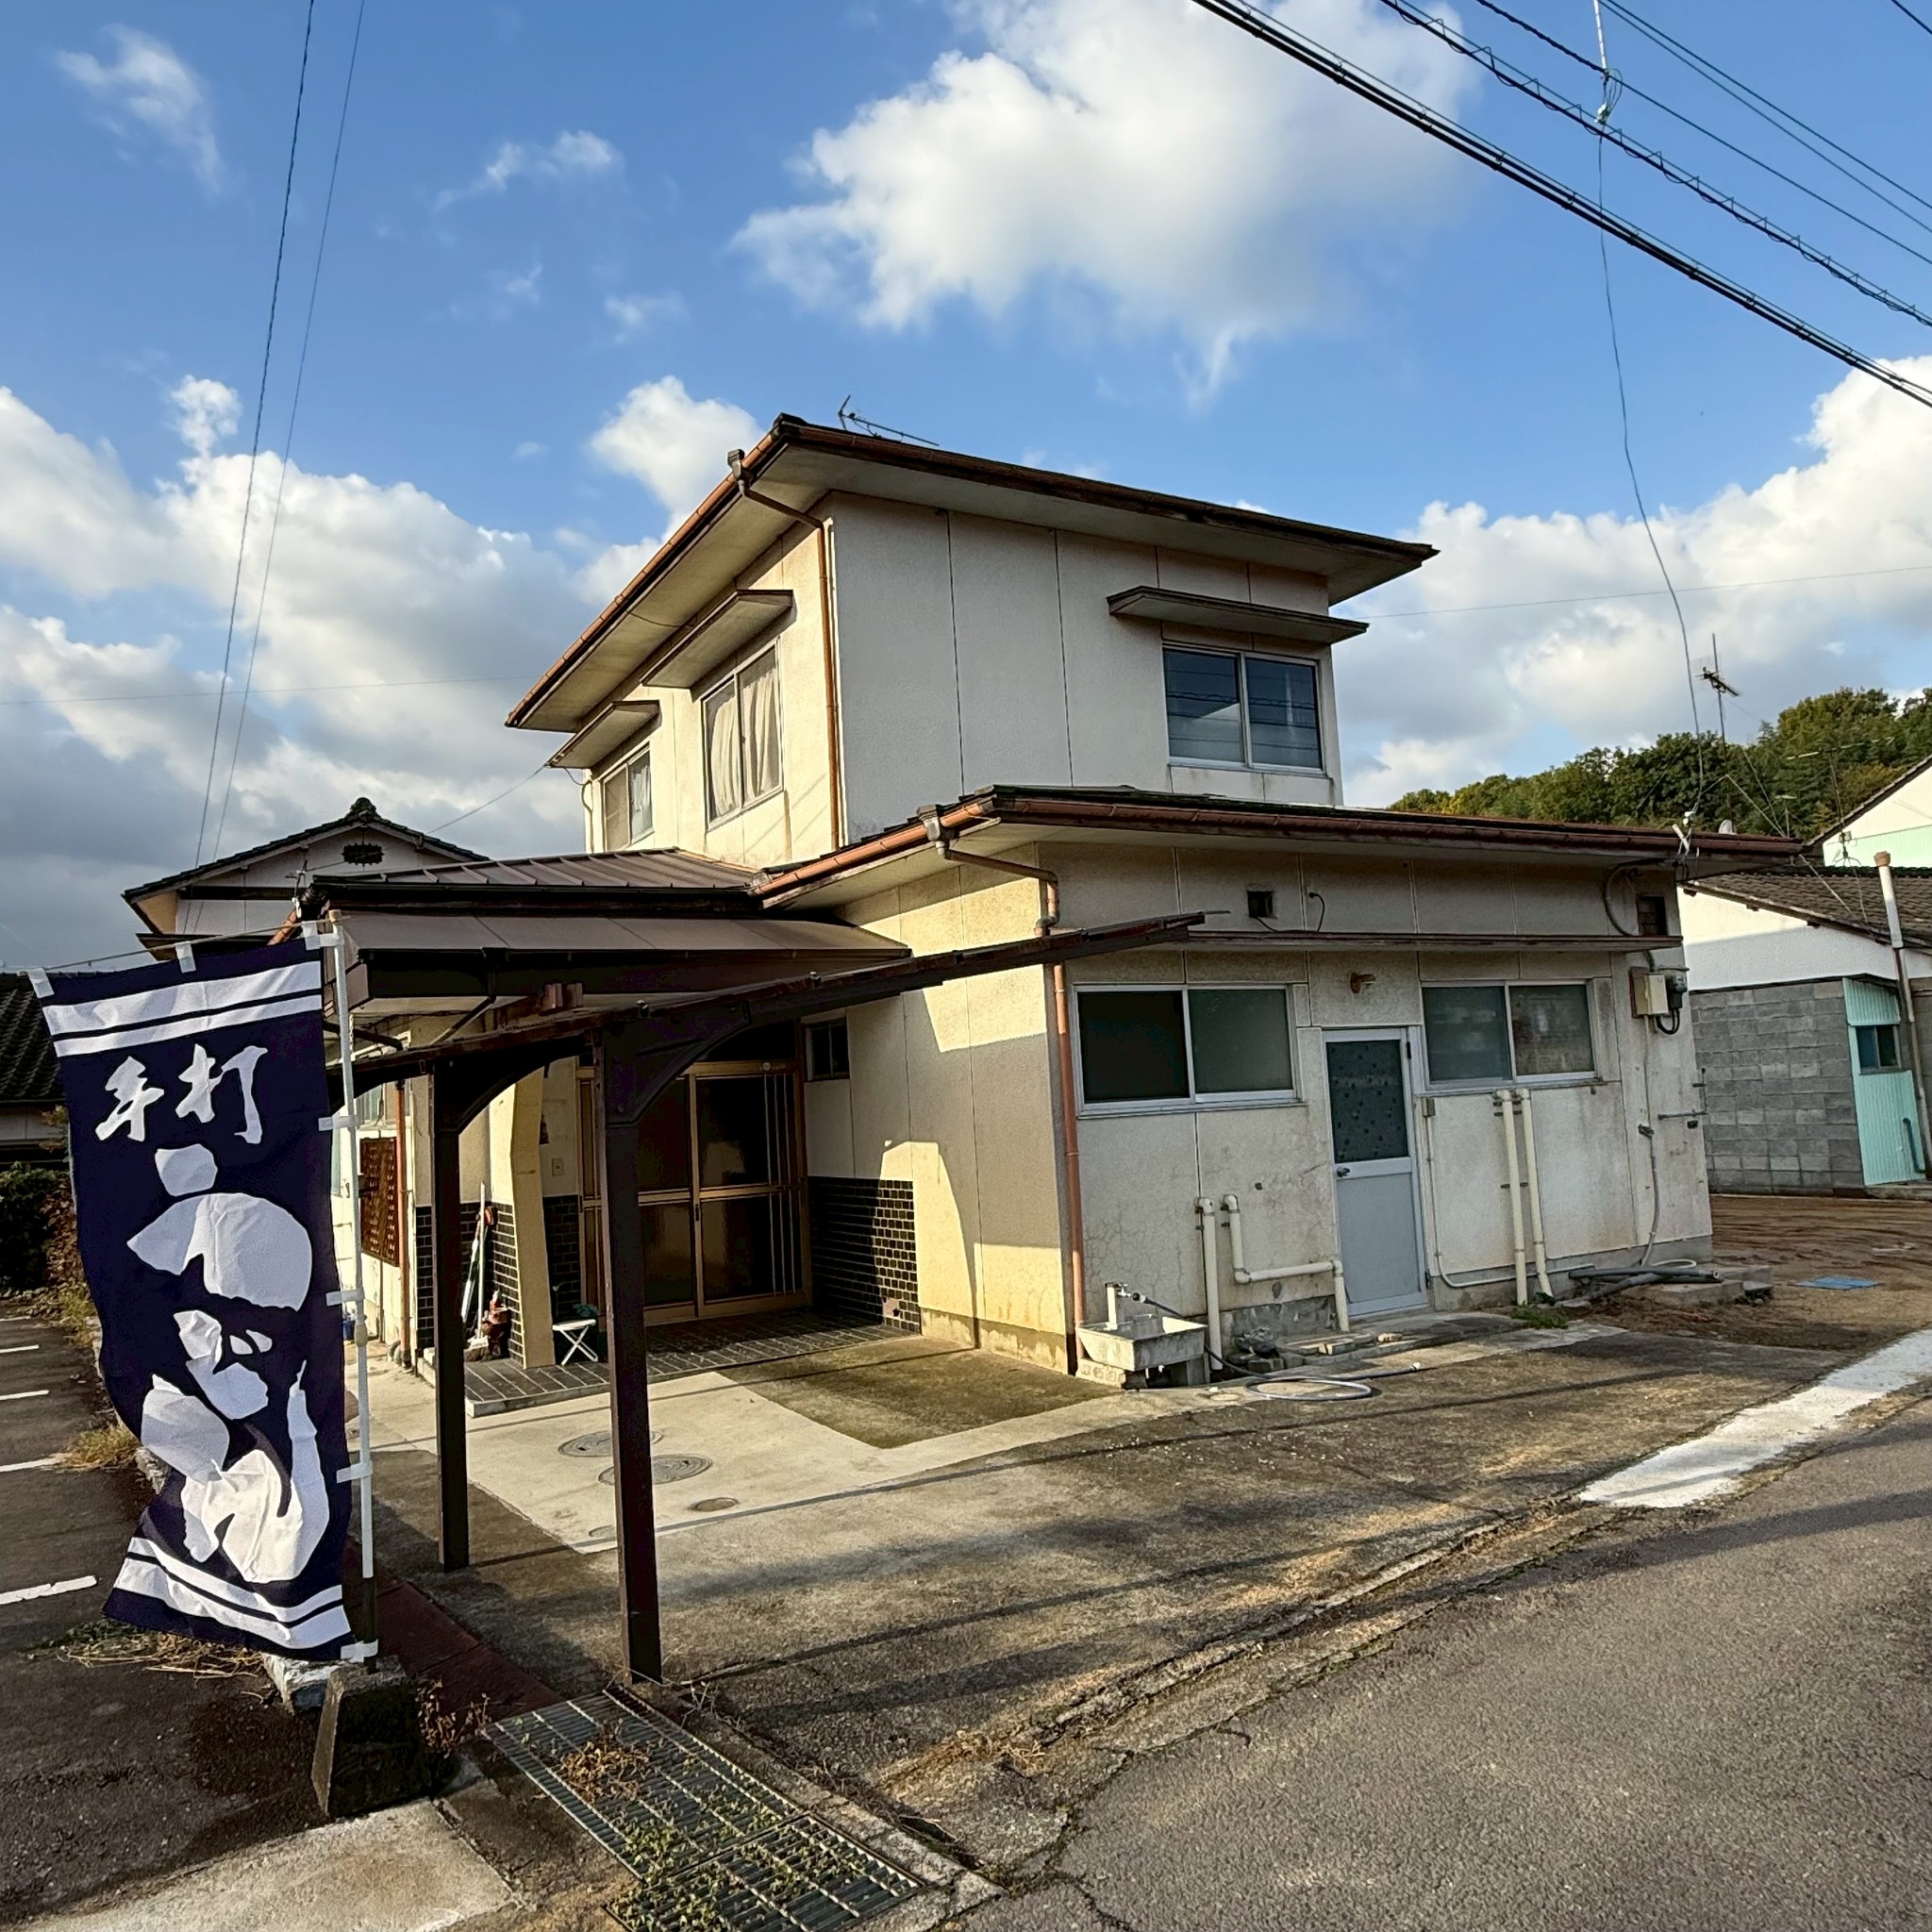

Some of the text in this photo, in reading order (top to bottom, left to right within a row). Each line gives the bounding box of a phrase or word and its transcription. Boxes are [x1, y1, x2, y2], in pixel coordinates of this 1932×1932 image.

[94, 1042, 269, 1145] 手打
[126, 1142, 330, 1584] うどん
